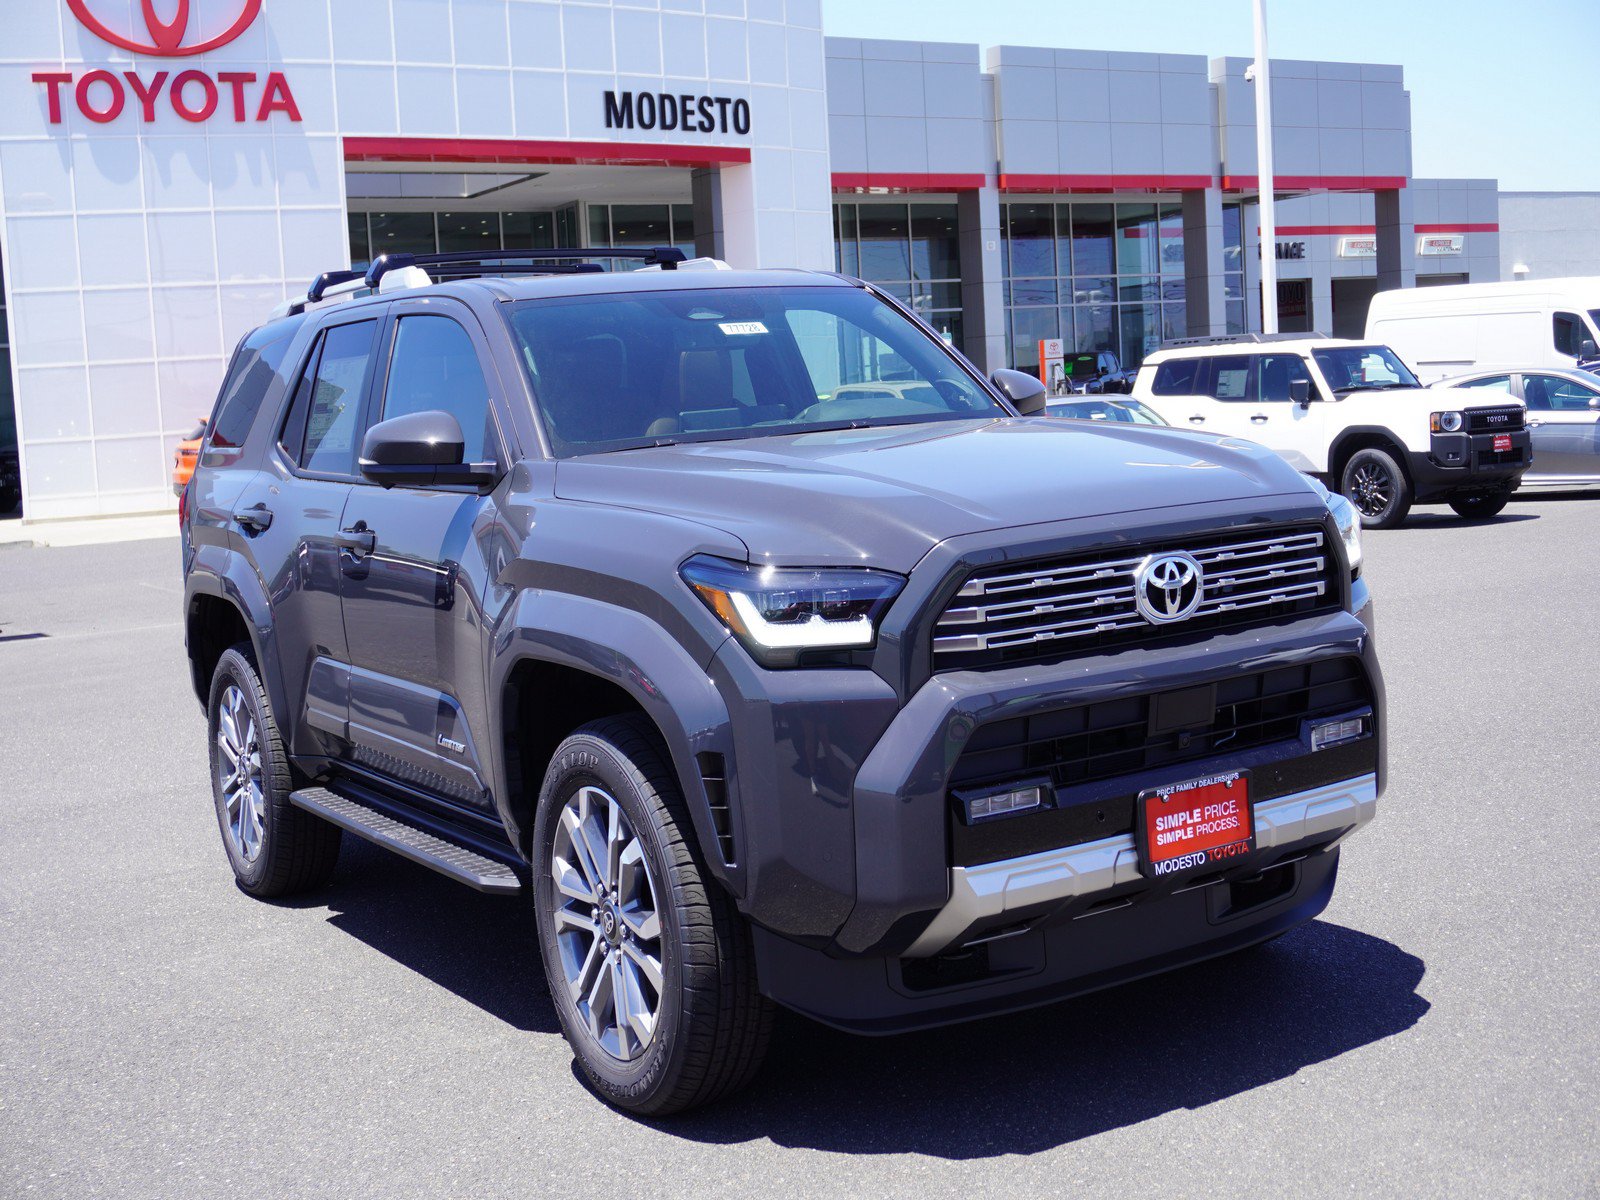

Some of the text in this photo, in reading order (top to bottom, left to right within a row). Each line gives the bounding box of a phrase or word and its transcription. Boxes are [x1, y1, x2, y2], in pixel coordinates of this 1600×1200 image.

[32, 69, 303, 124] TOYOTA
[604, 90, 751, 134] MODESTO
[726, 323, 761, 333] 77728
[1486, 415, 1508, 423] TOYOTA
[1156, 772, 1240, 797] PRICE FAMILY DEALERSHIPS
[1155, 799, 1240, 832] SIMPLE PRICE.
[1156, 816, 1241, 846] SIMPLE PROCESS.
[1154, 841, 1249, 876] MODESTO TOYOTA
